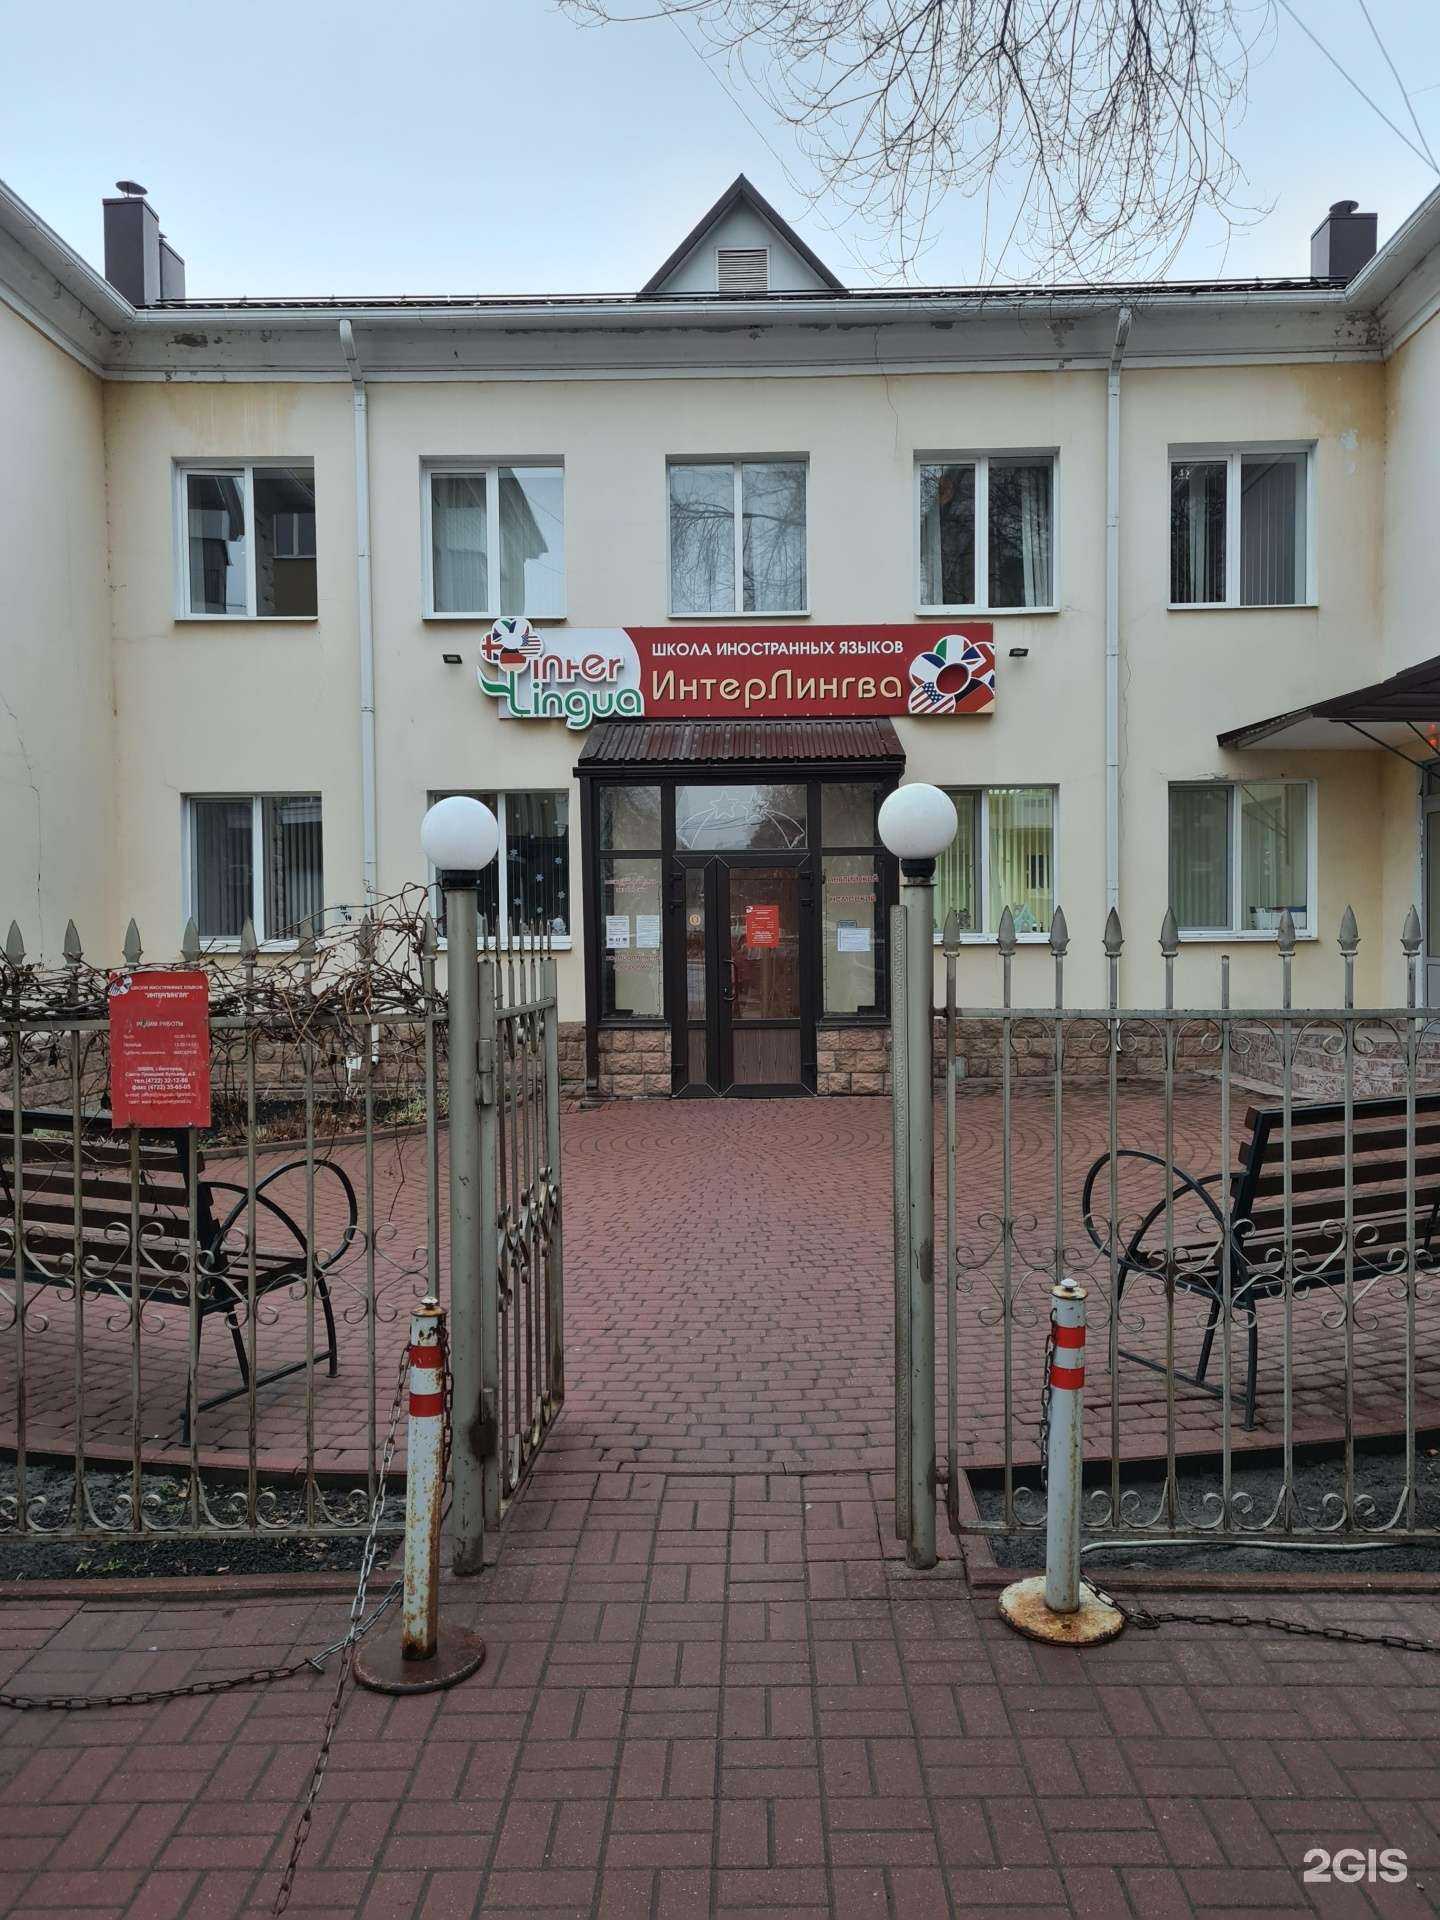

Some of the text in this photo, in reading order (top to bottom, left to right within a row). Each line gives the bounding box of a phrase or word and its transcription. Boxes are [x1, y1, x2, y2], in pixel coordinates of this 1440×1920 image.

[652, 640, 904, 656] ШКОЛА ИНОСТРАННЫХ ЯЗЫКОВ
[505, 671, 643, 728] Lingua
[652, 669, 902, 708] ИнтерЛингва
